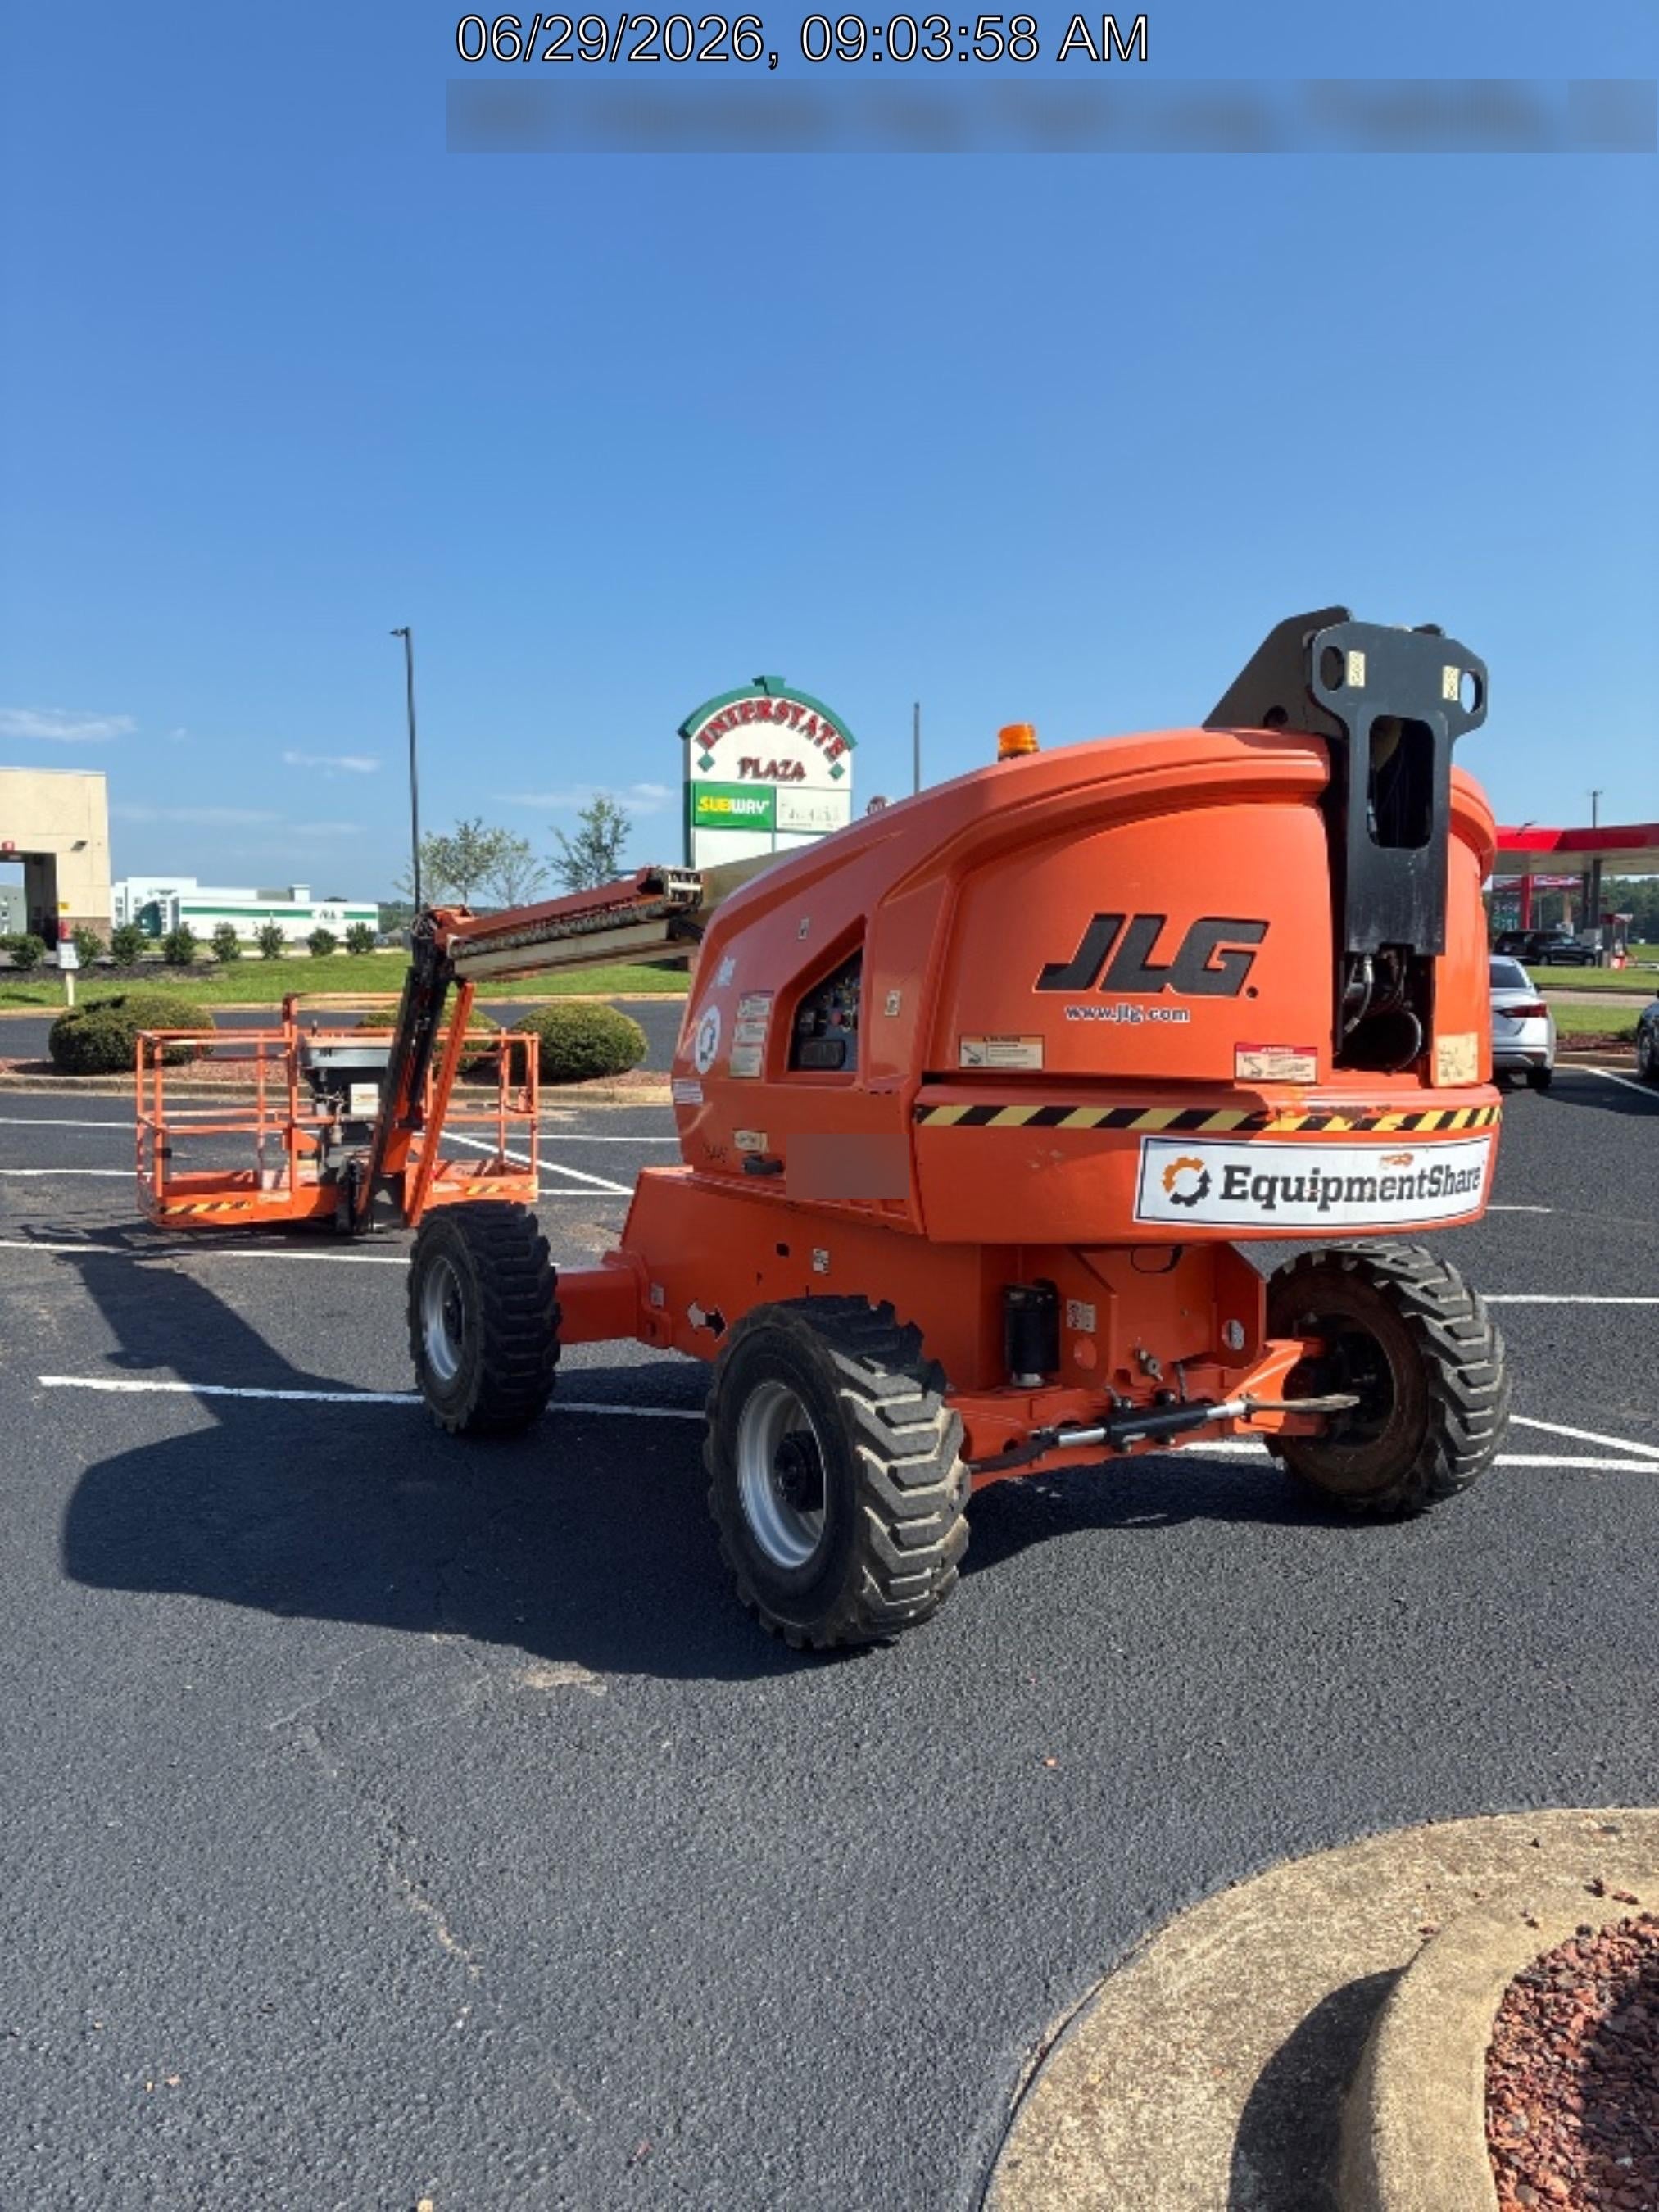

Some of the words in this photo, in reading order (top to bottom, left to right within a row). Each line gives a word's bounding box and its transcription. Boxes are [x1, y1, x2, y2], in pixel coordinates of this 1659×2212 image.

[696, 699, 849, 761] INTERSTATE
[738, 758, 806, 781] PLAZA
[698, 796, 769, 814] SUBWAY
[1065, 1004, 1190, 1024] www.jlg.com
[1219, 1163, 1480, 1211] EquipmentShare
